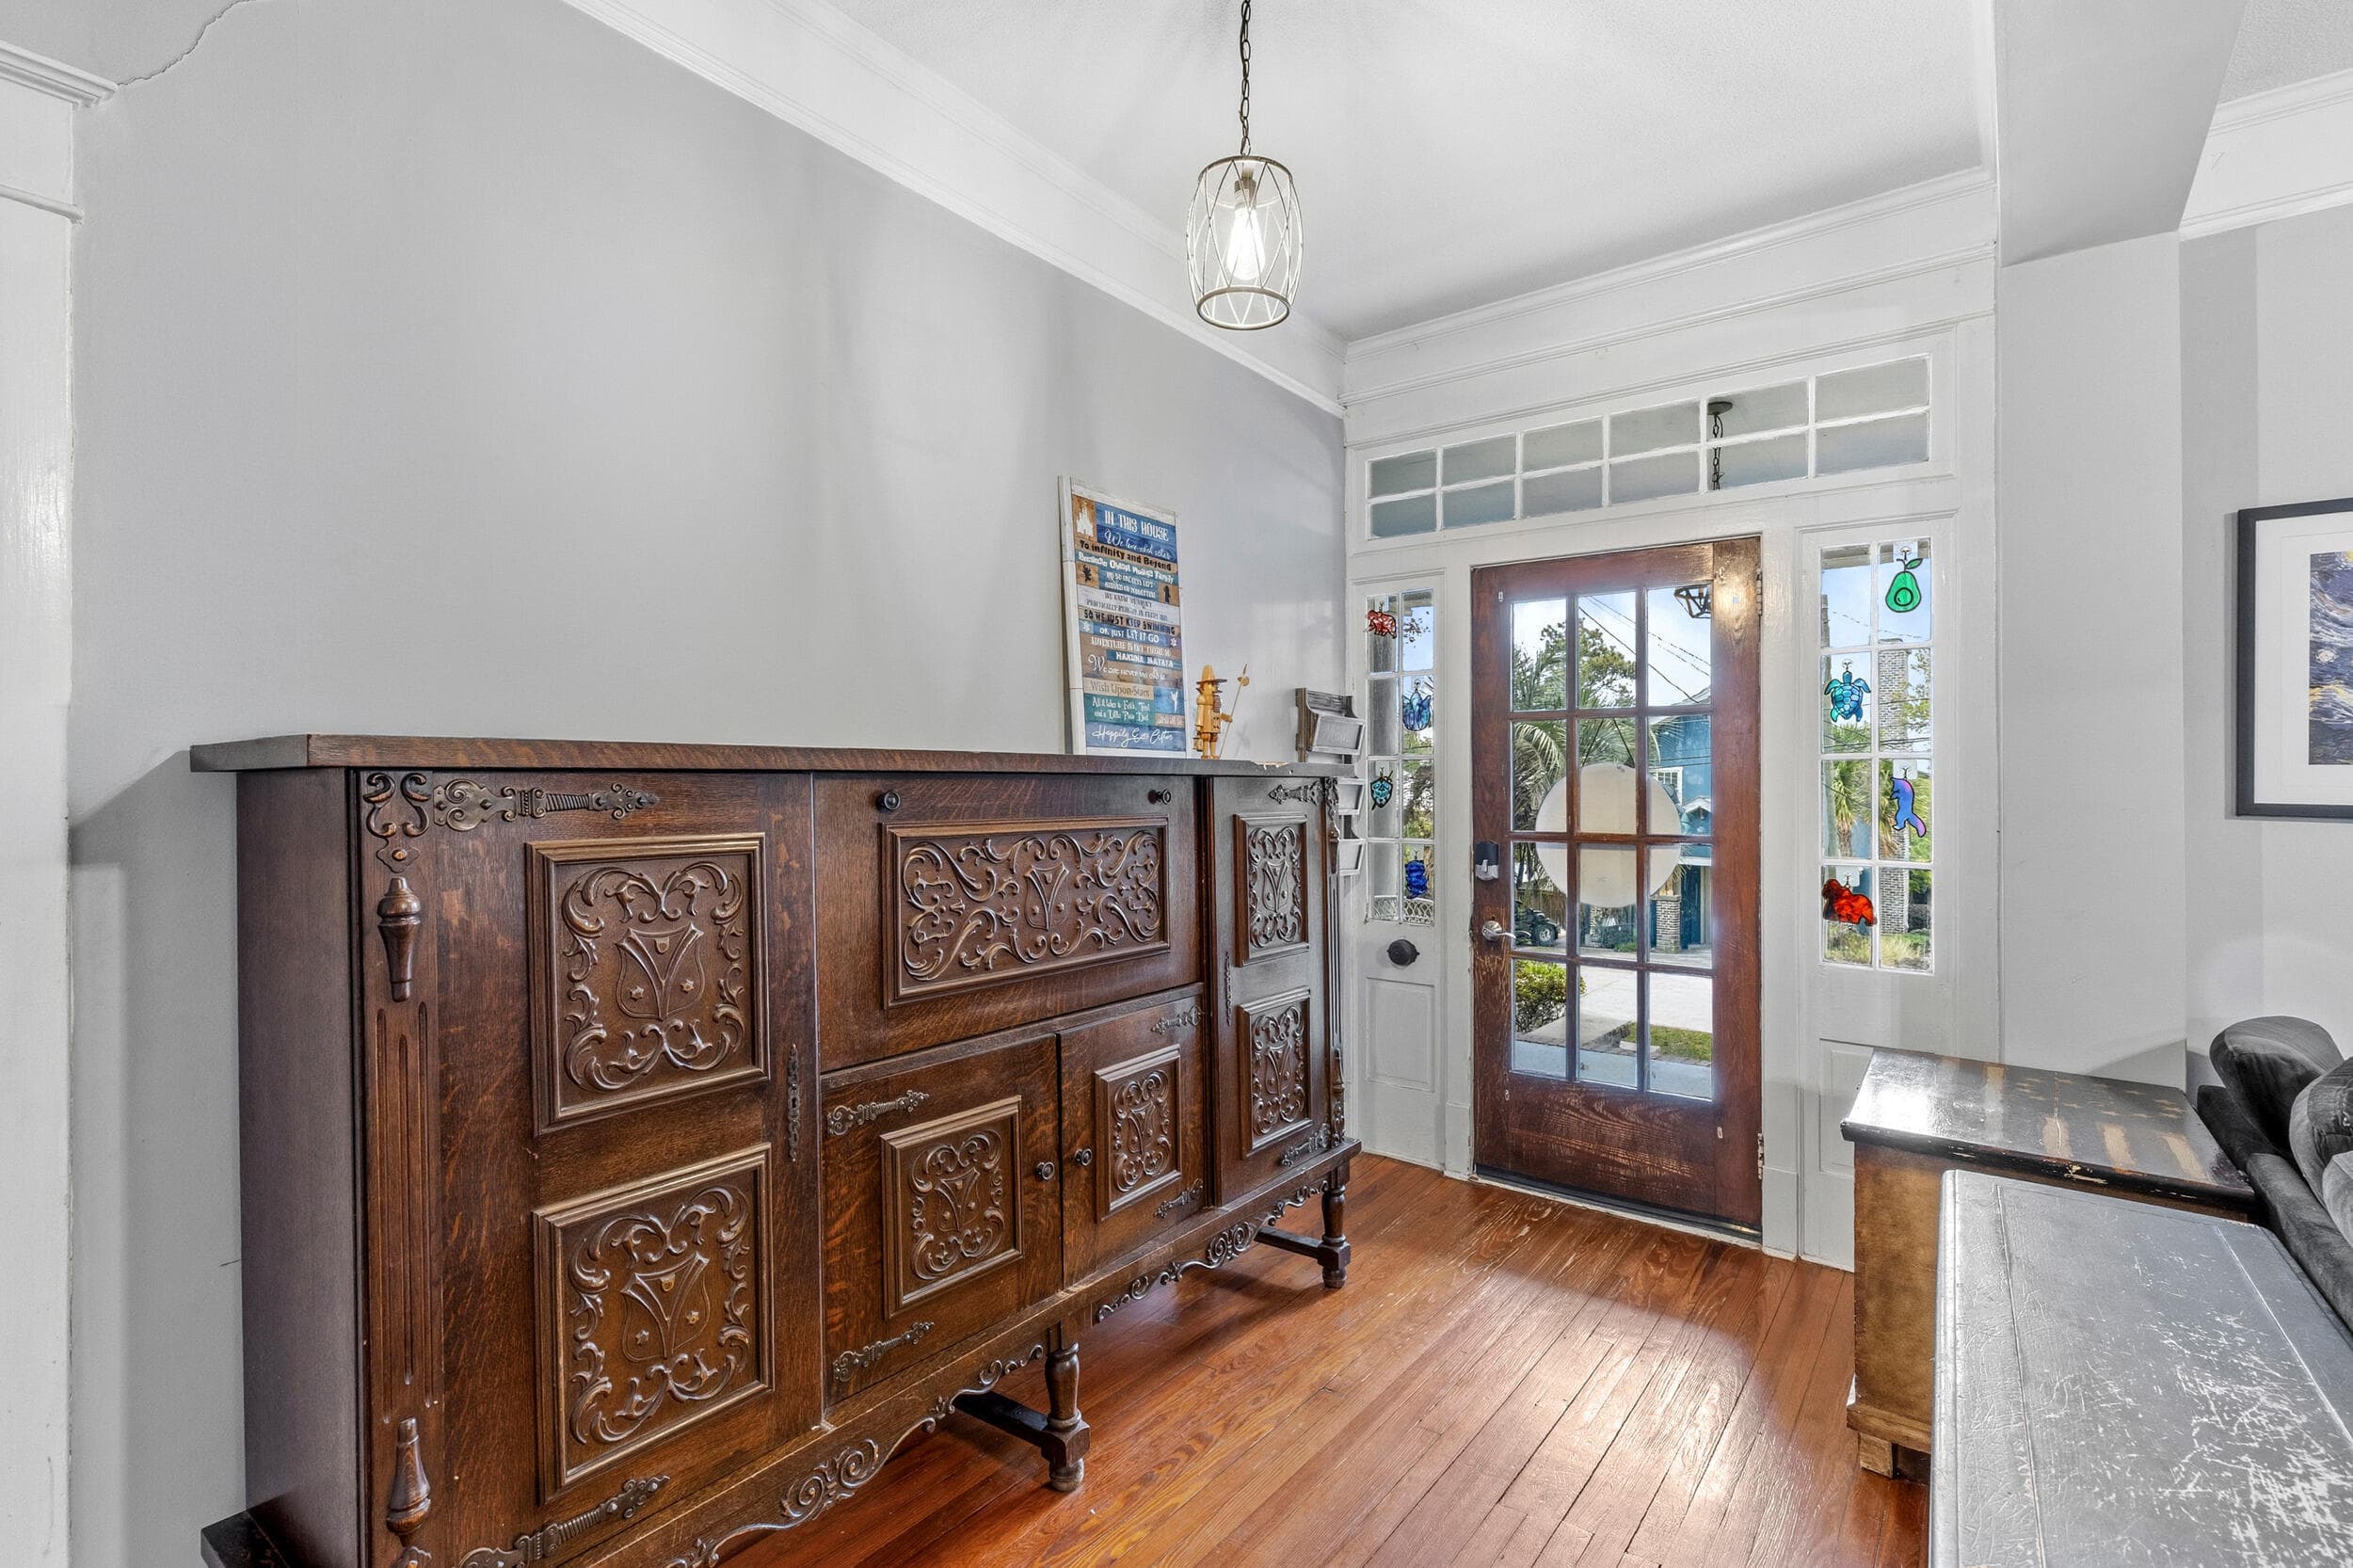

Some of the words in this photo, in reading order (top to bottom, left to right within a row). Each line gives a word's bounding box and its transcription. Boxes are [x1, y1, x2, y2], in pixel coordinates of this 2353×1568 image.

[1104, 510, 1114, 526] IN
[1118, 514, 1138, 533] THIS
[1141, 520, 1169, 542] HOUSE
[1104, 528, 1124, 547] We
[1080, 539, 1090, 550] To
[1127, 552, 1142, 564] and
[1144, 556, 1172, 571] Beyond
[1083, 609, 1094, 619] SO
[1107, 613, 1124, 626] JUST
[1147, 633, 1160, 643] GO
[1088, 653, 1107, 673] We
[1091, 680, 1110, 693] Wish
[1111, 682, 1132, 696] Upon
[1091, 725, 1130, 748] Happily
